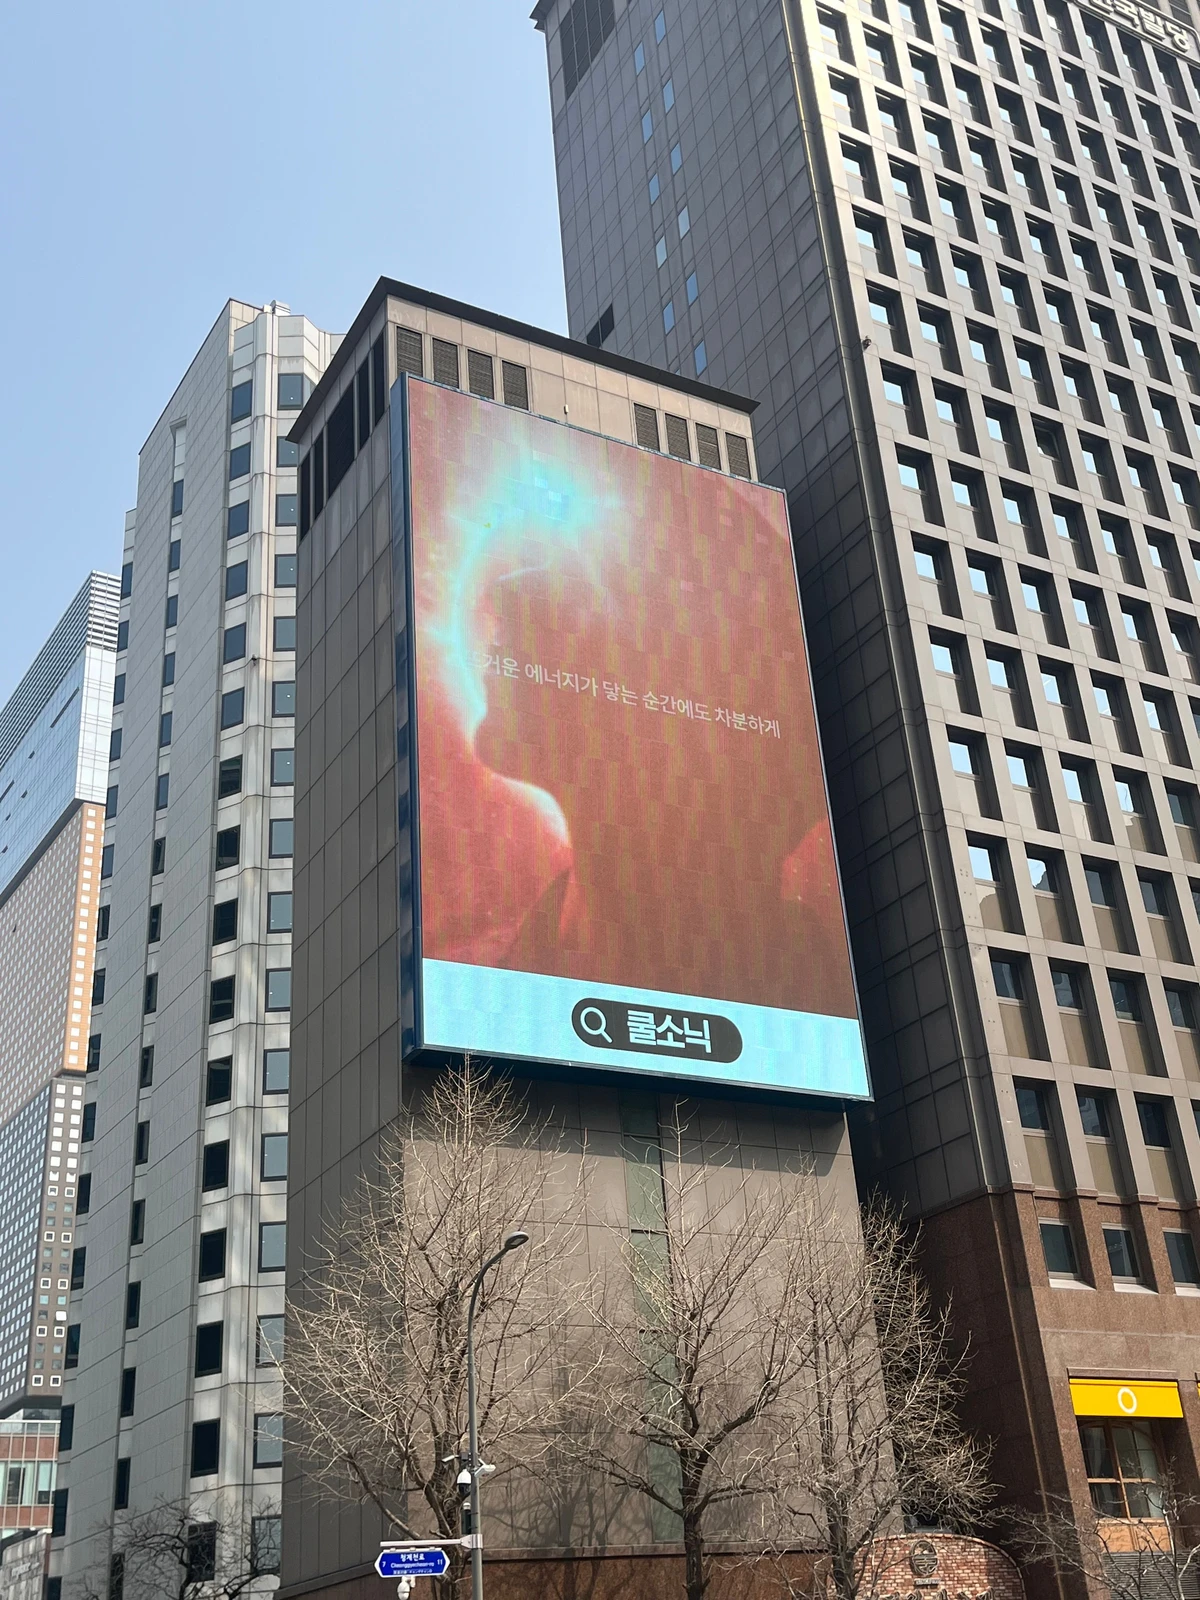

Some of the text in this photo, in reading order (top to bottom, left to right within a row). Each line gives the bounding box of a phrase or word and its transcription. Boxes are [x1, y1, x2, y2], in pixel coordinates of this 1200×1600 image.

[525, 663, 598, 697] 에너지가
[602, 680, 638, 706] 닿는
[642, 691, 712, 722] 순간에도
[714, 706, 781, 739] 차분하게
[627, 1009, 712, 1054] 쿨소닉
[400, 1553, 425, 1562] 청계천로
